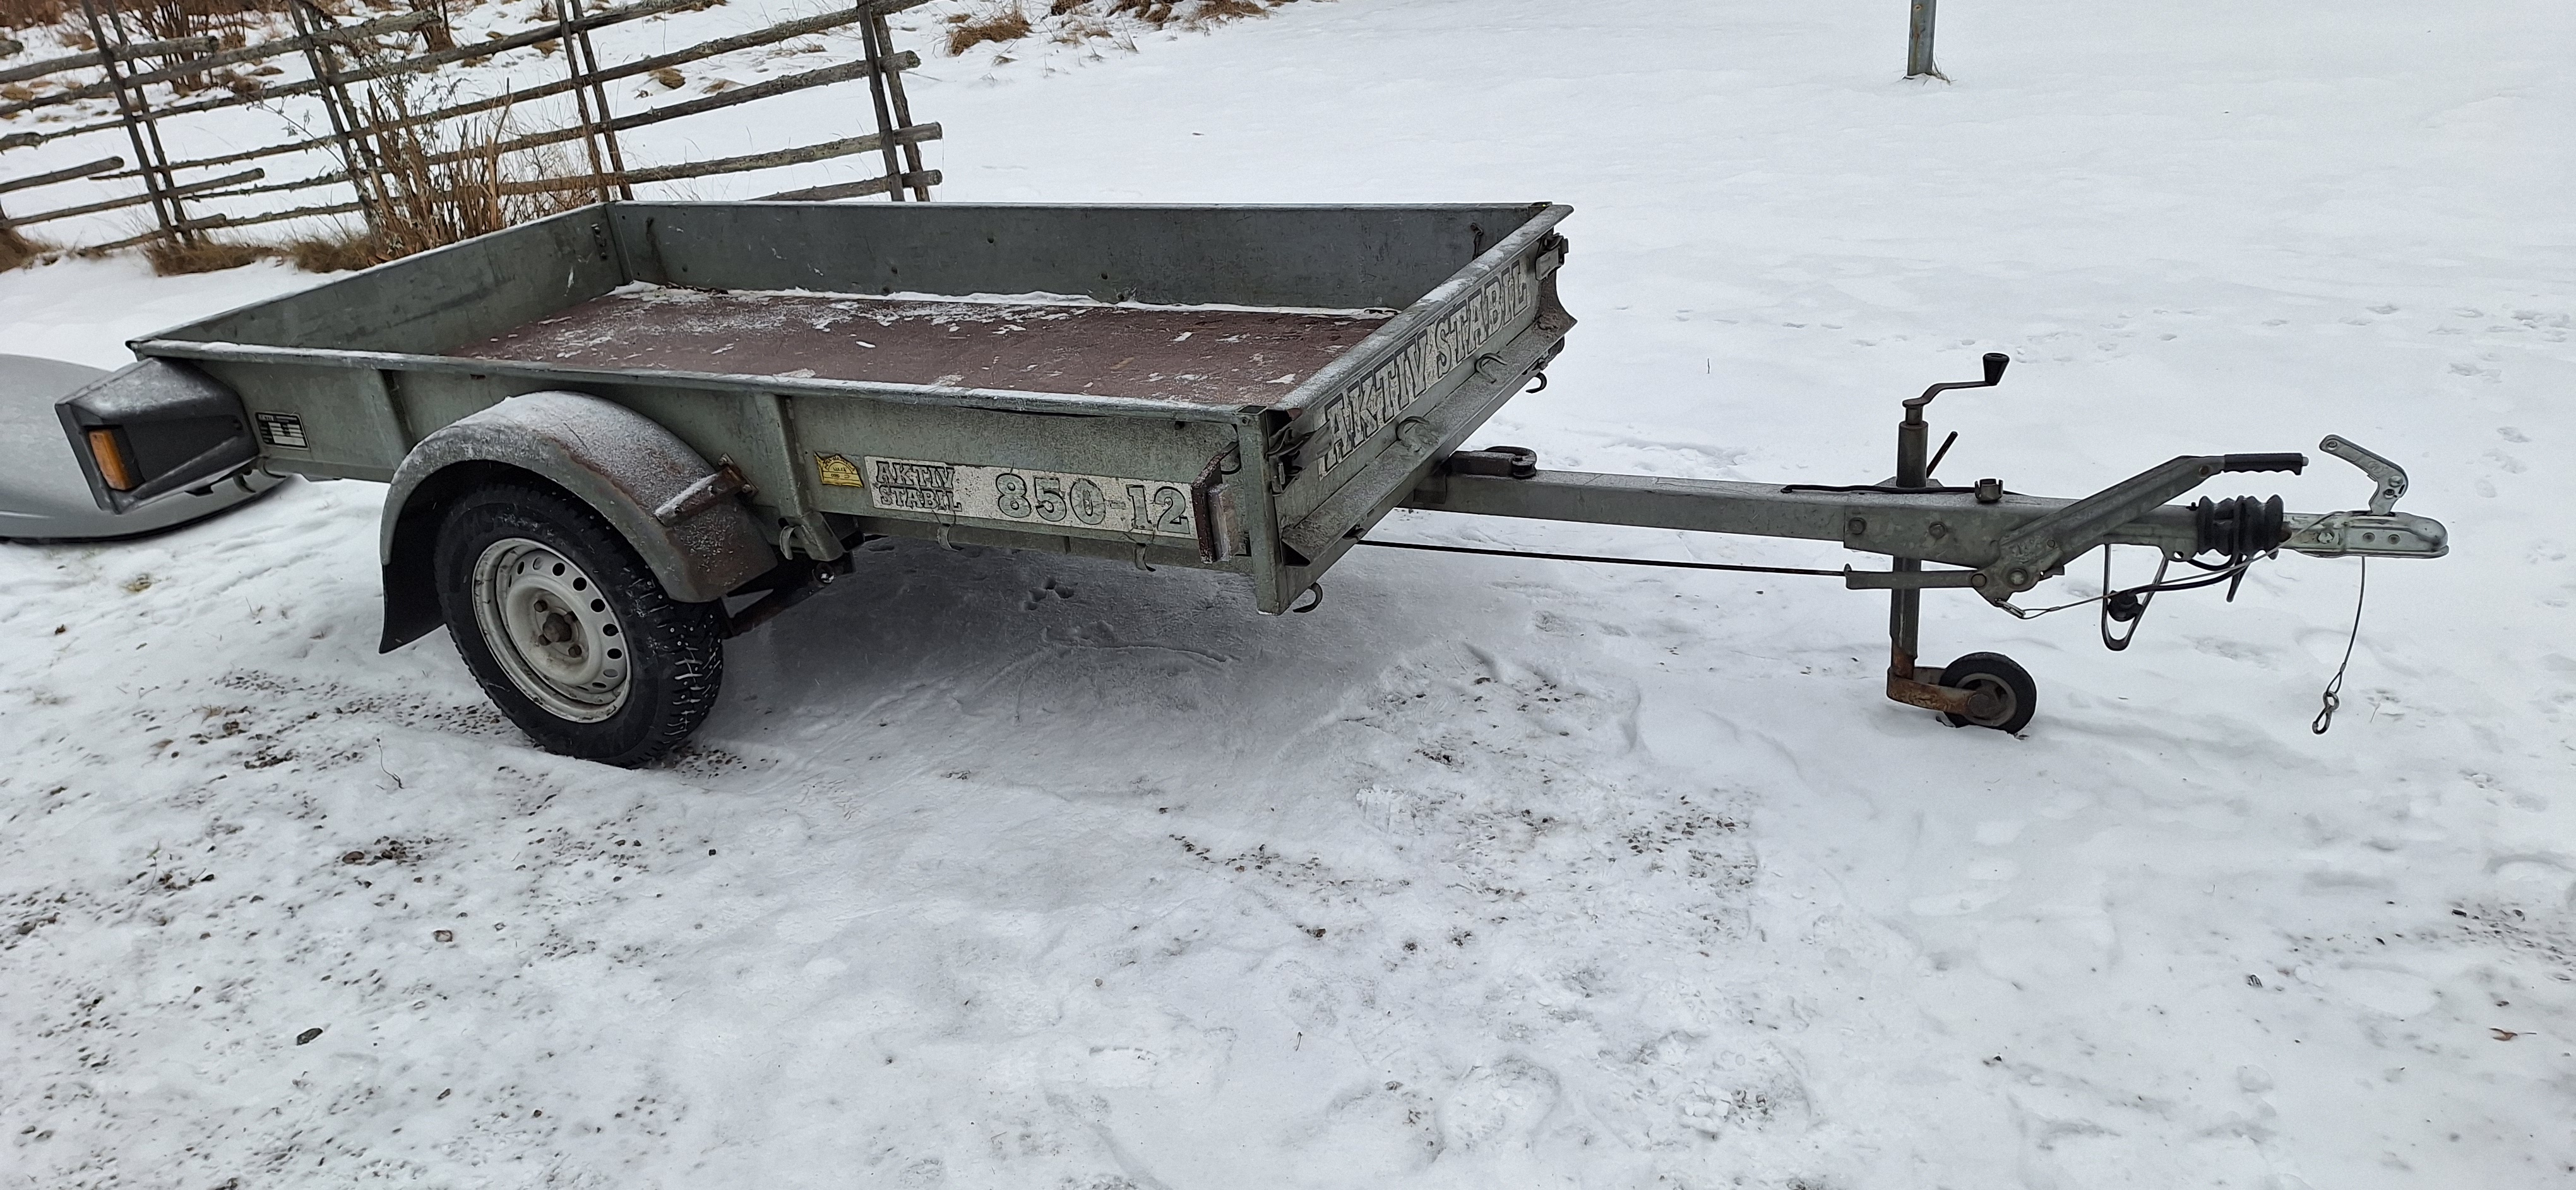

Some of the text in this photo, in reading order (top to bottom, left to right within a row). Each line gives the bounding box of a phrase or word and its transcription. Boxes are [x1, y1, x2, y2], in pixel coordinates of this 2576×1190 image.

[1325, 260, 1530, 473] AKTIV STABIL
[876, 462, 955, 490] AKTIV
[880, 484, 962, 512] STABIL
[996, 473, 1190, 534] 850-12
